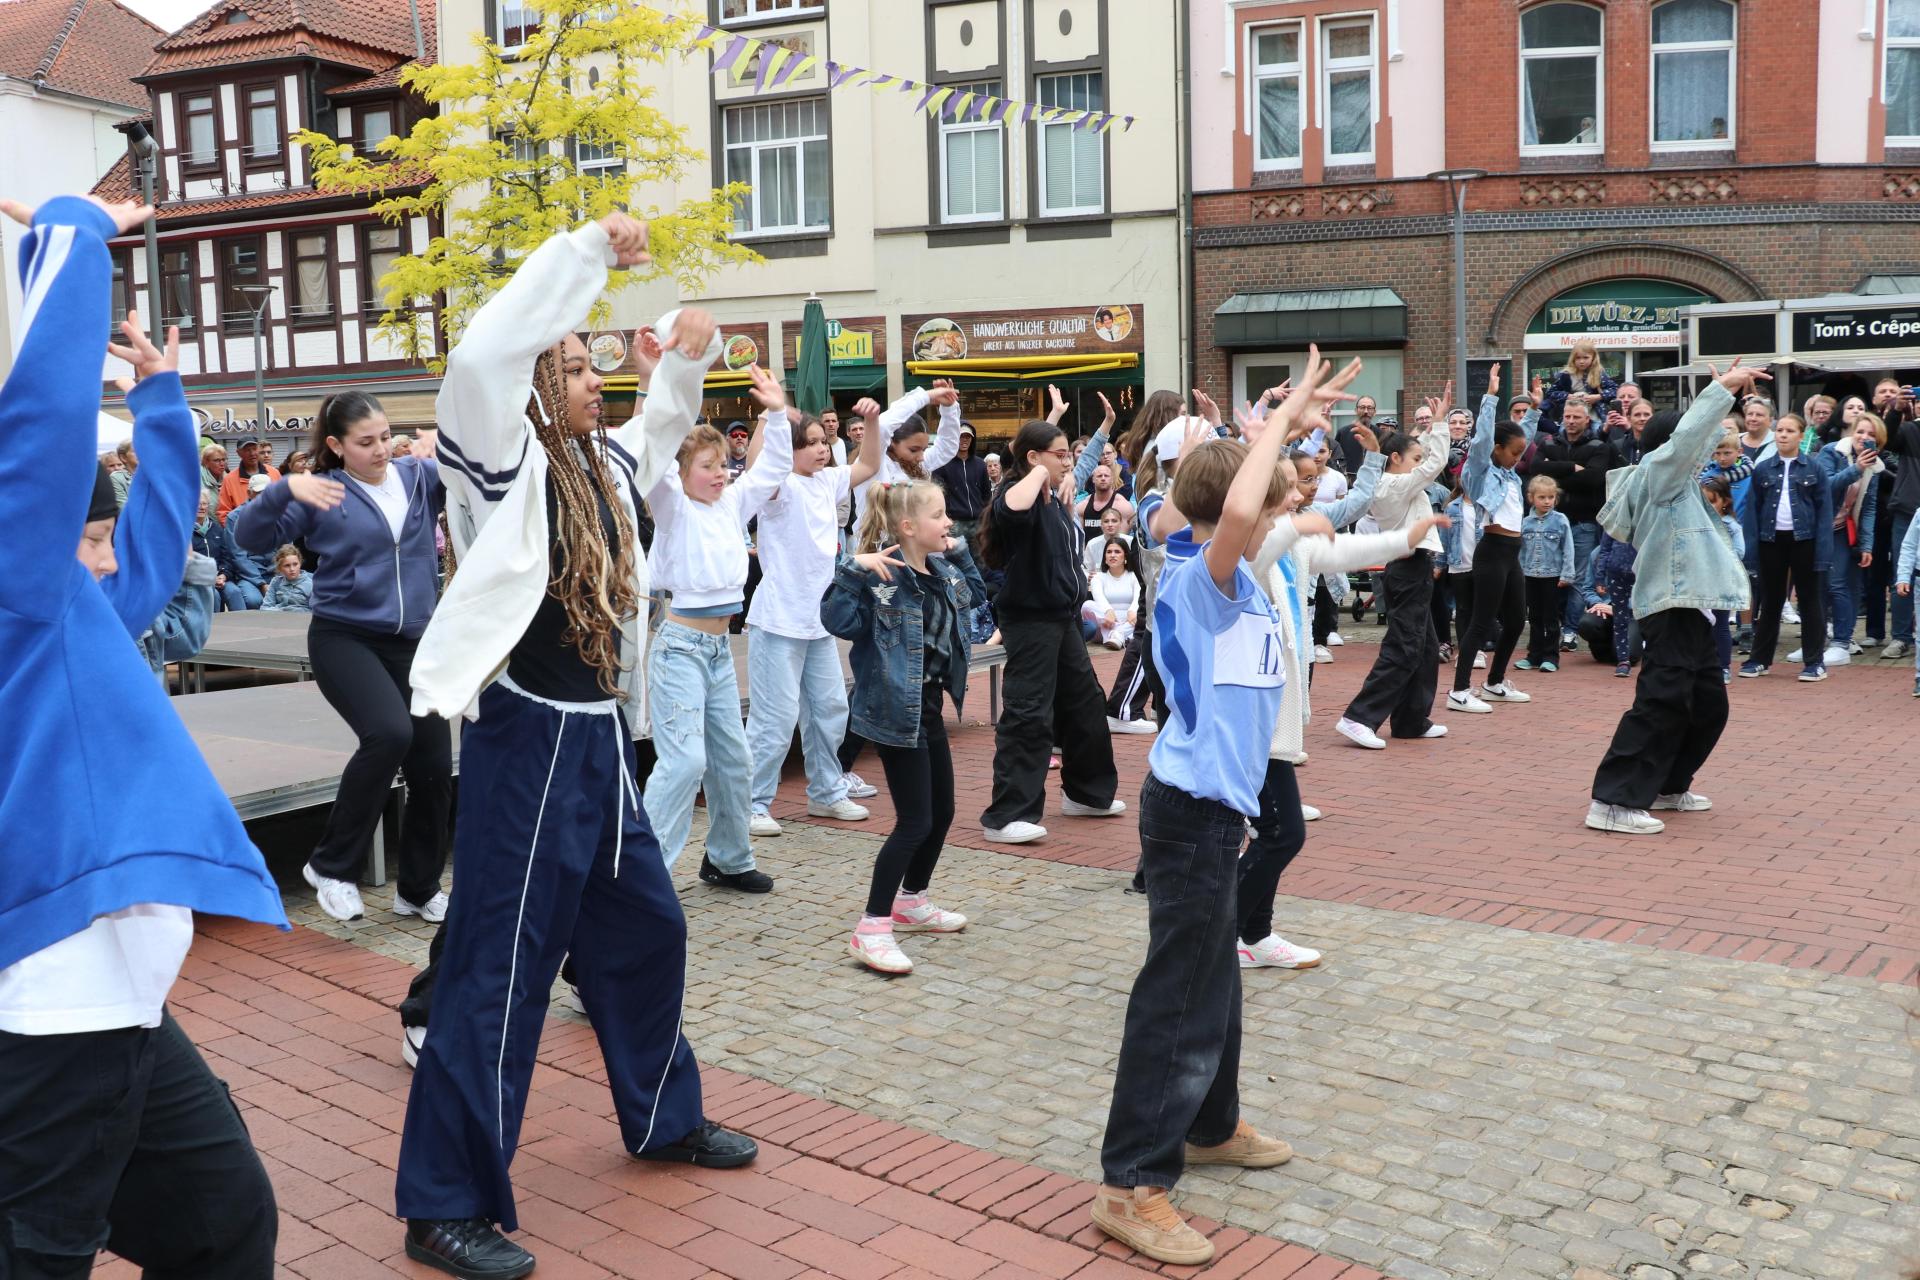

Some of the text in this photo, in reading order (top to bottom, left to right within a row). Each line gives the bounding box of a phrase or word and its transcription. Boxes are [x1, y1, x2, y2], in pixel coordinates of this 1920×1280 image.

[1550, 306, 1582, 324] DIE
[973, 317, 1086, 337] HANDWERKLICHE QUALITÄT
[1632, 324, 1664, 332] genießen
[983, 339, 1076, 351] DIREKT AUS UNSERER BACKSTUBE
